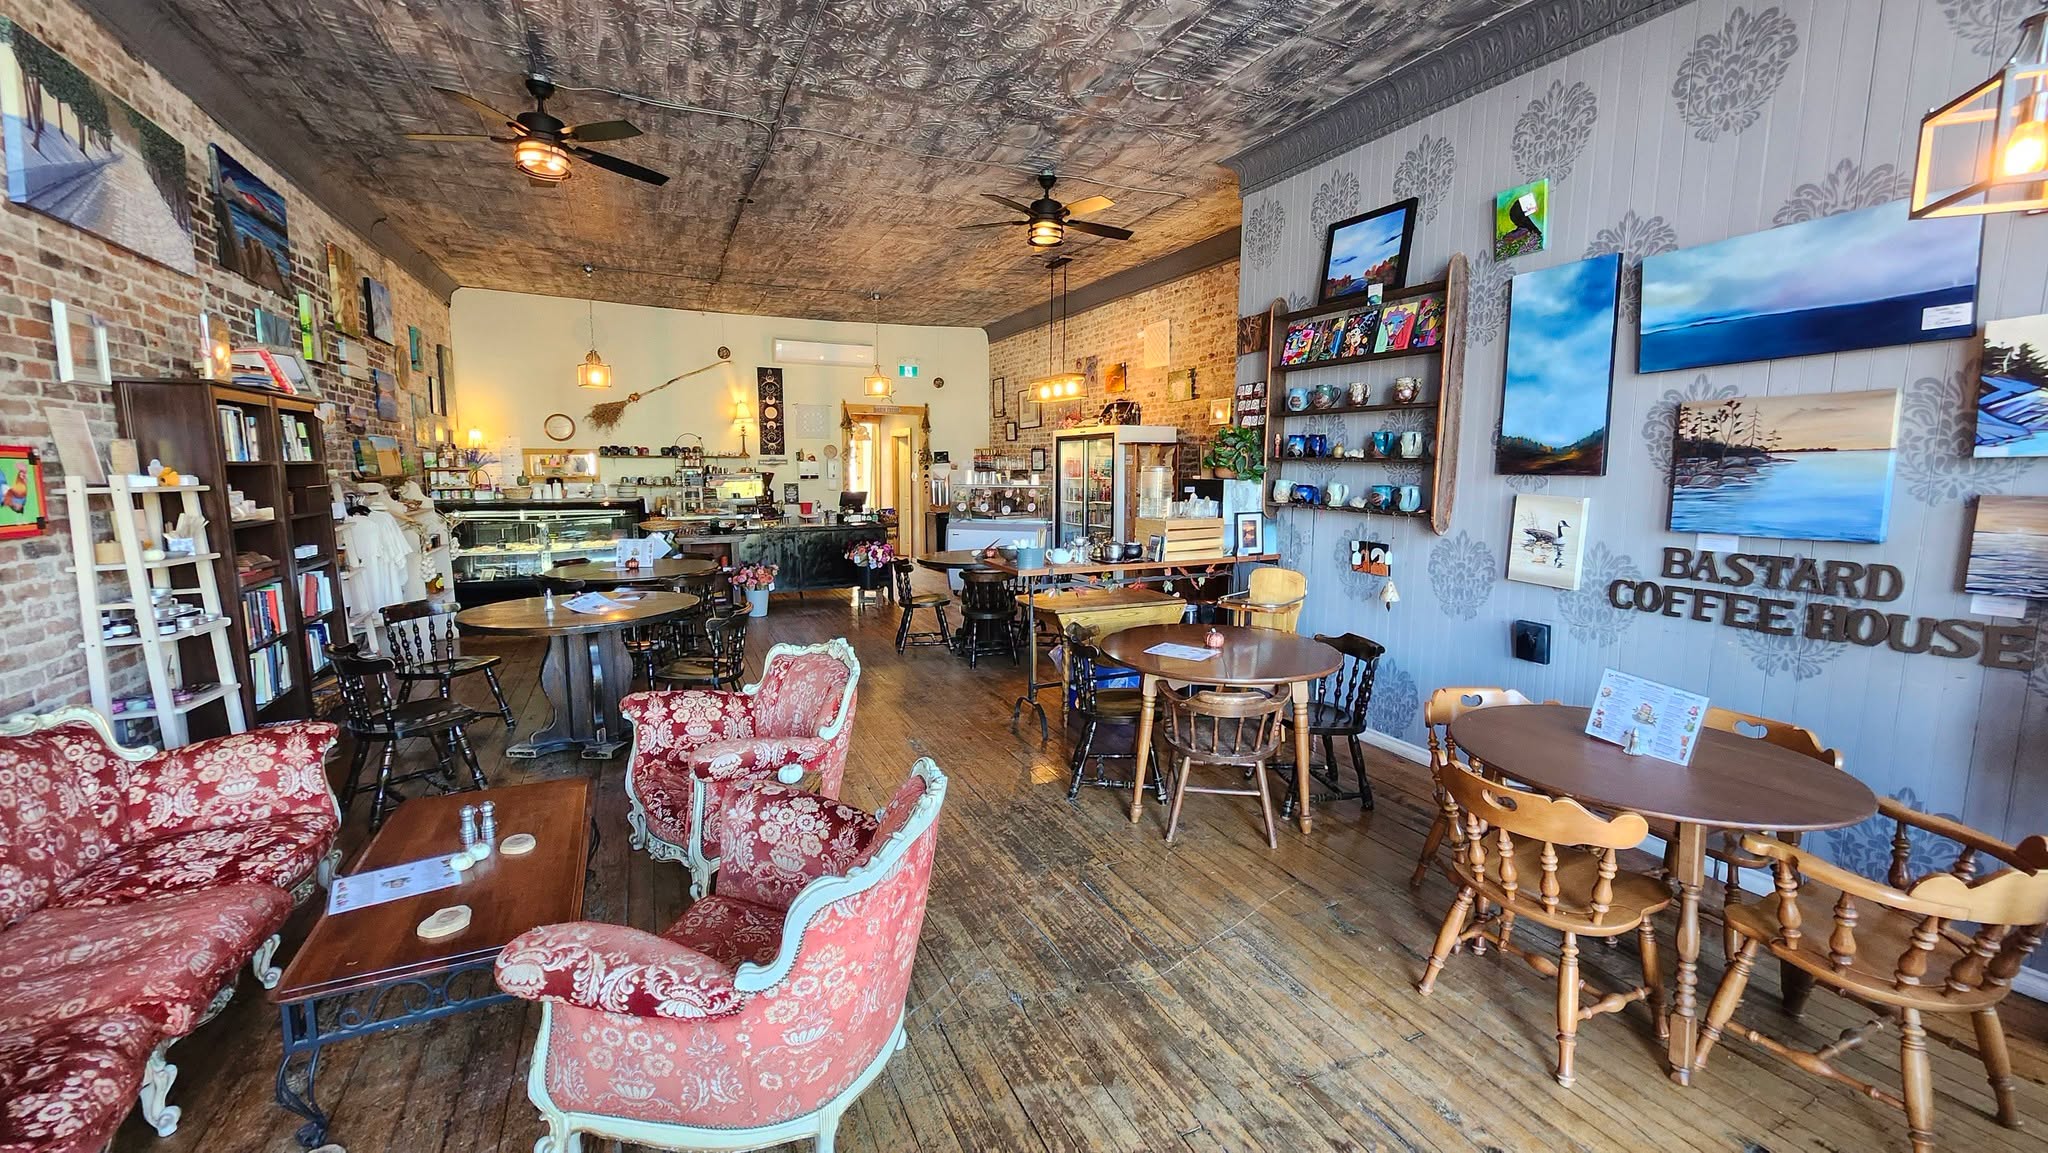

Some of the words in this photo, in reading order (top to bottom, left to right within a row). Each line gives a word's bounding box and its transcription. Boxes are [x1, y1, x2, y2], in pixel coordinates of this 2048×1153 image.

[1661, 547, 1904, 602] BASTARD
[1608, 579, 1795, 636] COFFEE
[1805, 602, 2037, 671] HOUSE
